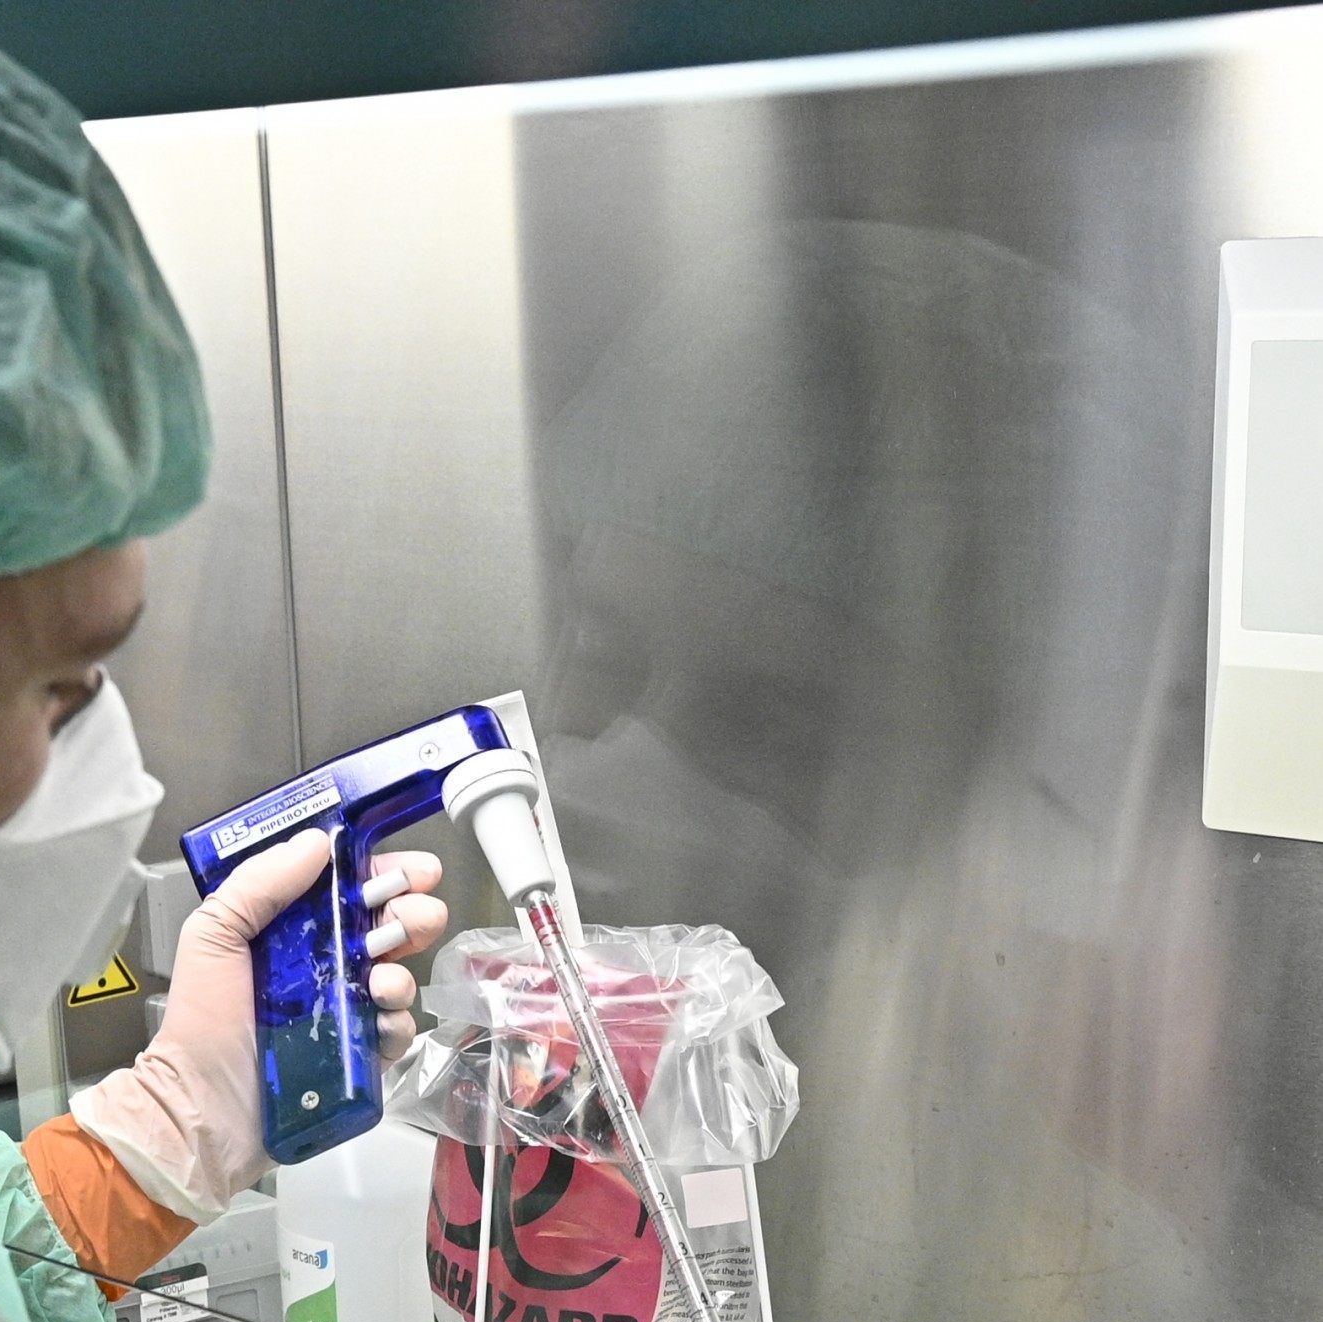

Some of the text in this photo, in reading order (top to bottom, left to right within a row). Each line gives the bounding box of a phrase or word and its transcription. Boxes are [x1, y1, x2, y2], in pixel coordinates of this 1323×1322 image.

[247, 777, 335, 826] INTEGRA BIOSCIENCES
[260, 804, 310, 835] PIPETBOY
[210, 819, 251, 851] IBS
[292, 1248, 321, 1267] arcana
[678, 1241, 689, 1256] 3
[700, 1291, 710, 1305] 4
